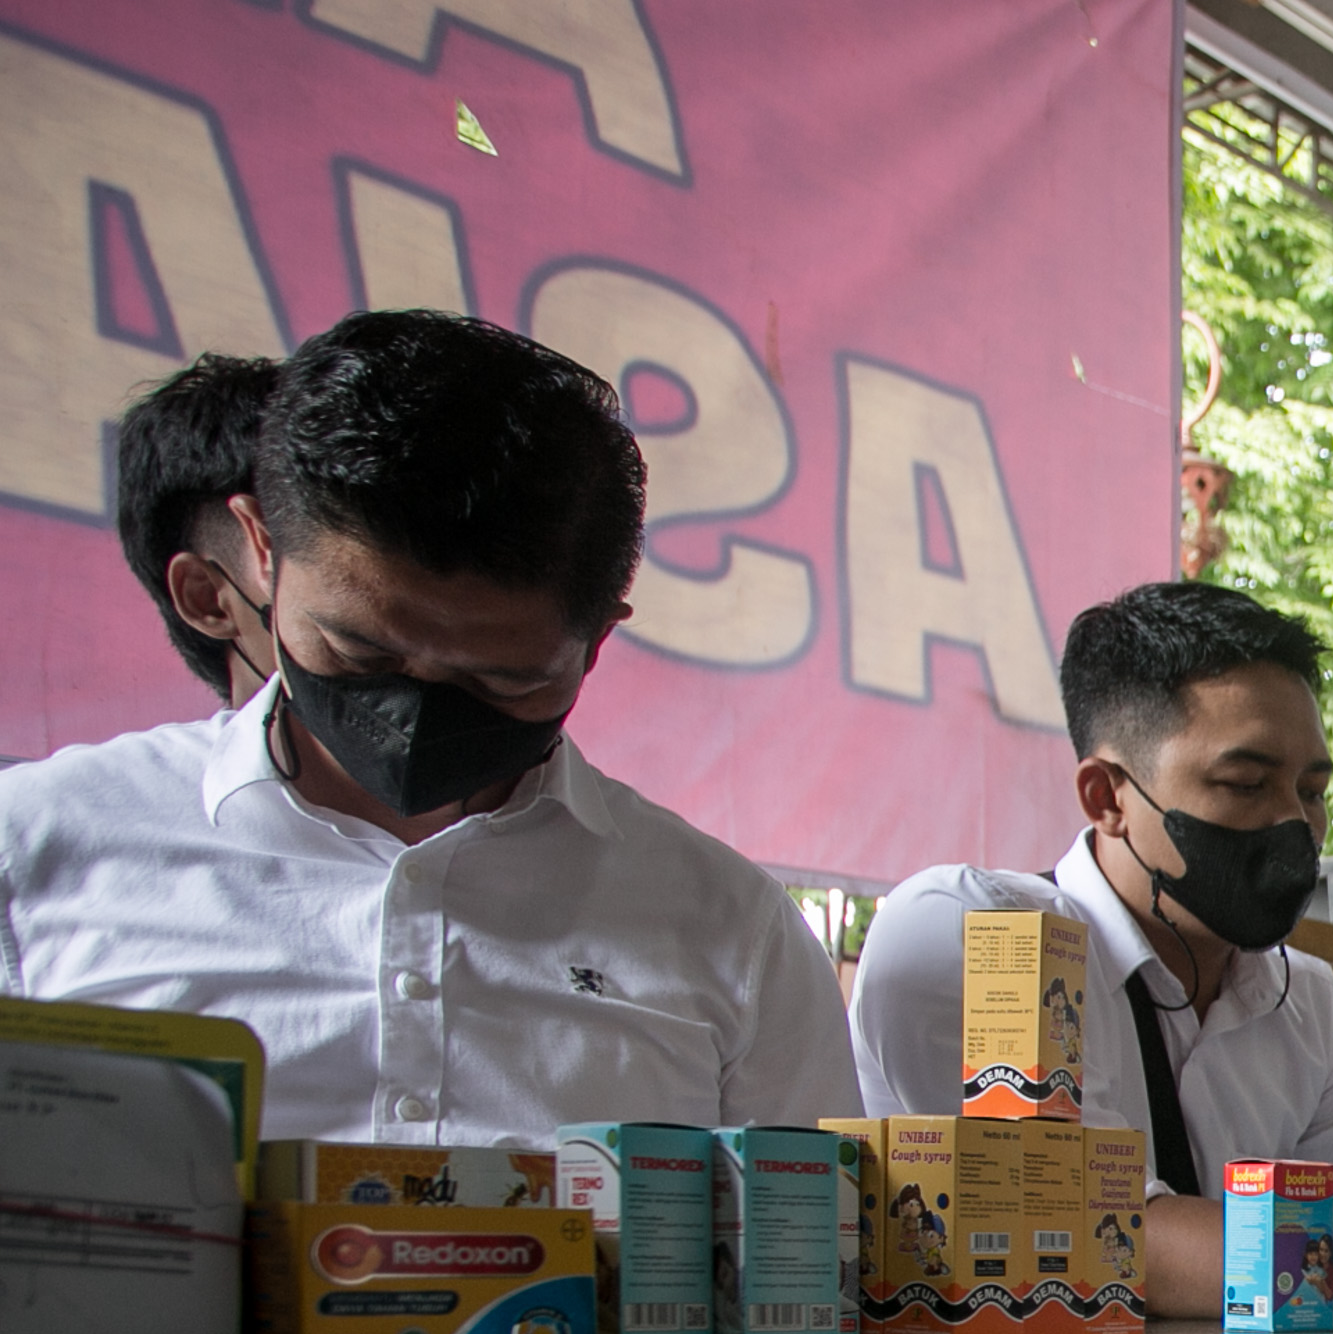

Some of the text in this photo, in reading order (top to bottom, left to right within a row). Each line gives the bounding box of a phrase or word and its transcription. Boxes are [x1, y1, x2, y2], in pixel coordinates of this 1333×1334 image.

[1050, 927, 1083, 946] UNIBEBI
[1045, 942, 1068, 960] Cough
[1067, 950, 1088, 966] syrup
[977, 1067, 1026, 1090] DEMAM
[1049, 1071, 1075, 1092] BATUK
[899, 1131, 945, 1145] UNIBEBI
[982, 1130, 1001, 1141] Netto
[1013, 1130, 1022, 1141] ml
[1044, 1131, 1064, 1142] Netto
[890, 1148, 953, 1165] Cough syrup
[1095, 1142, 1137, 1157] UNIBEBI
[629, 1155, 707, 1173] TERMOREX
[753, 1159, 832, 1175] TERMOREX
[1088, 1159, 1146, 1176] Cough syrup
[1232, 1167, 1267, 1183] bodrexin
[1285, 1169, 1328, 1186] bodrexin
[391, 1240, 531, 1266] Redoxon
[899, 1285, 939, 1309] BATUK
[967, 1283, 1012, 1311] DEMAM
[1032, 1283, 1074, 1305] DEMAM
[1097, 1286, 1134, 1306] BATUK
